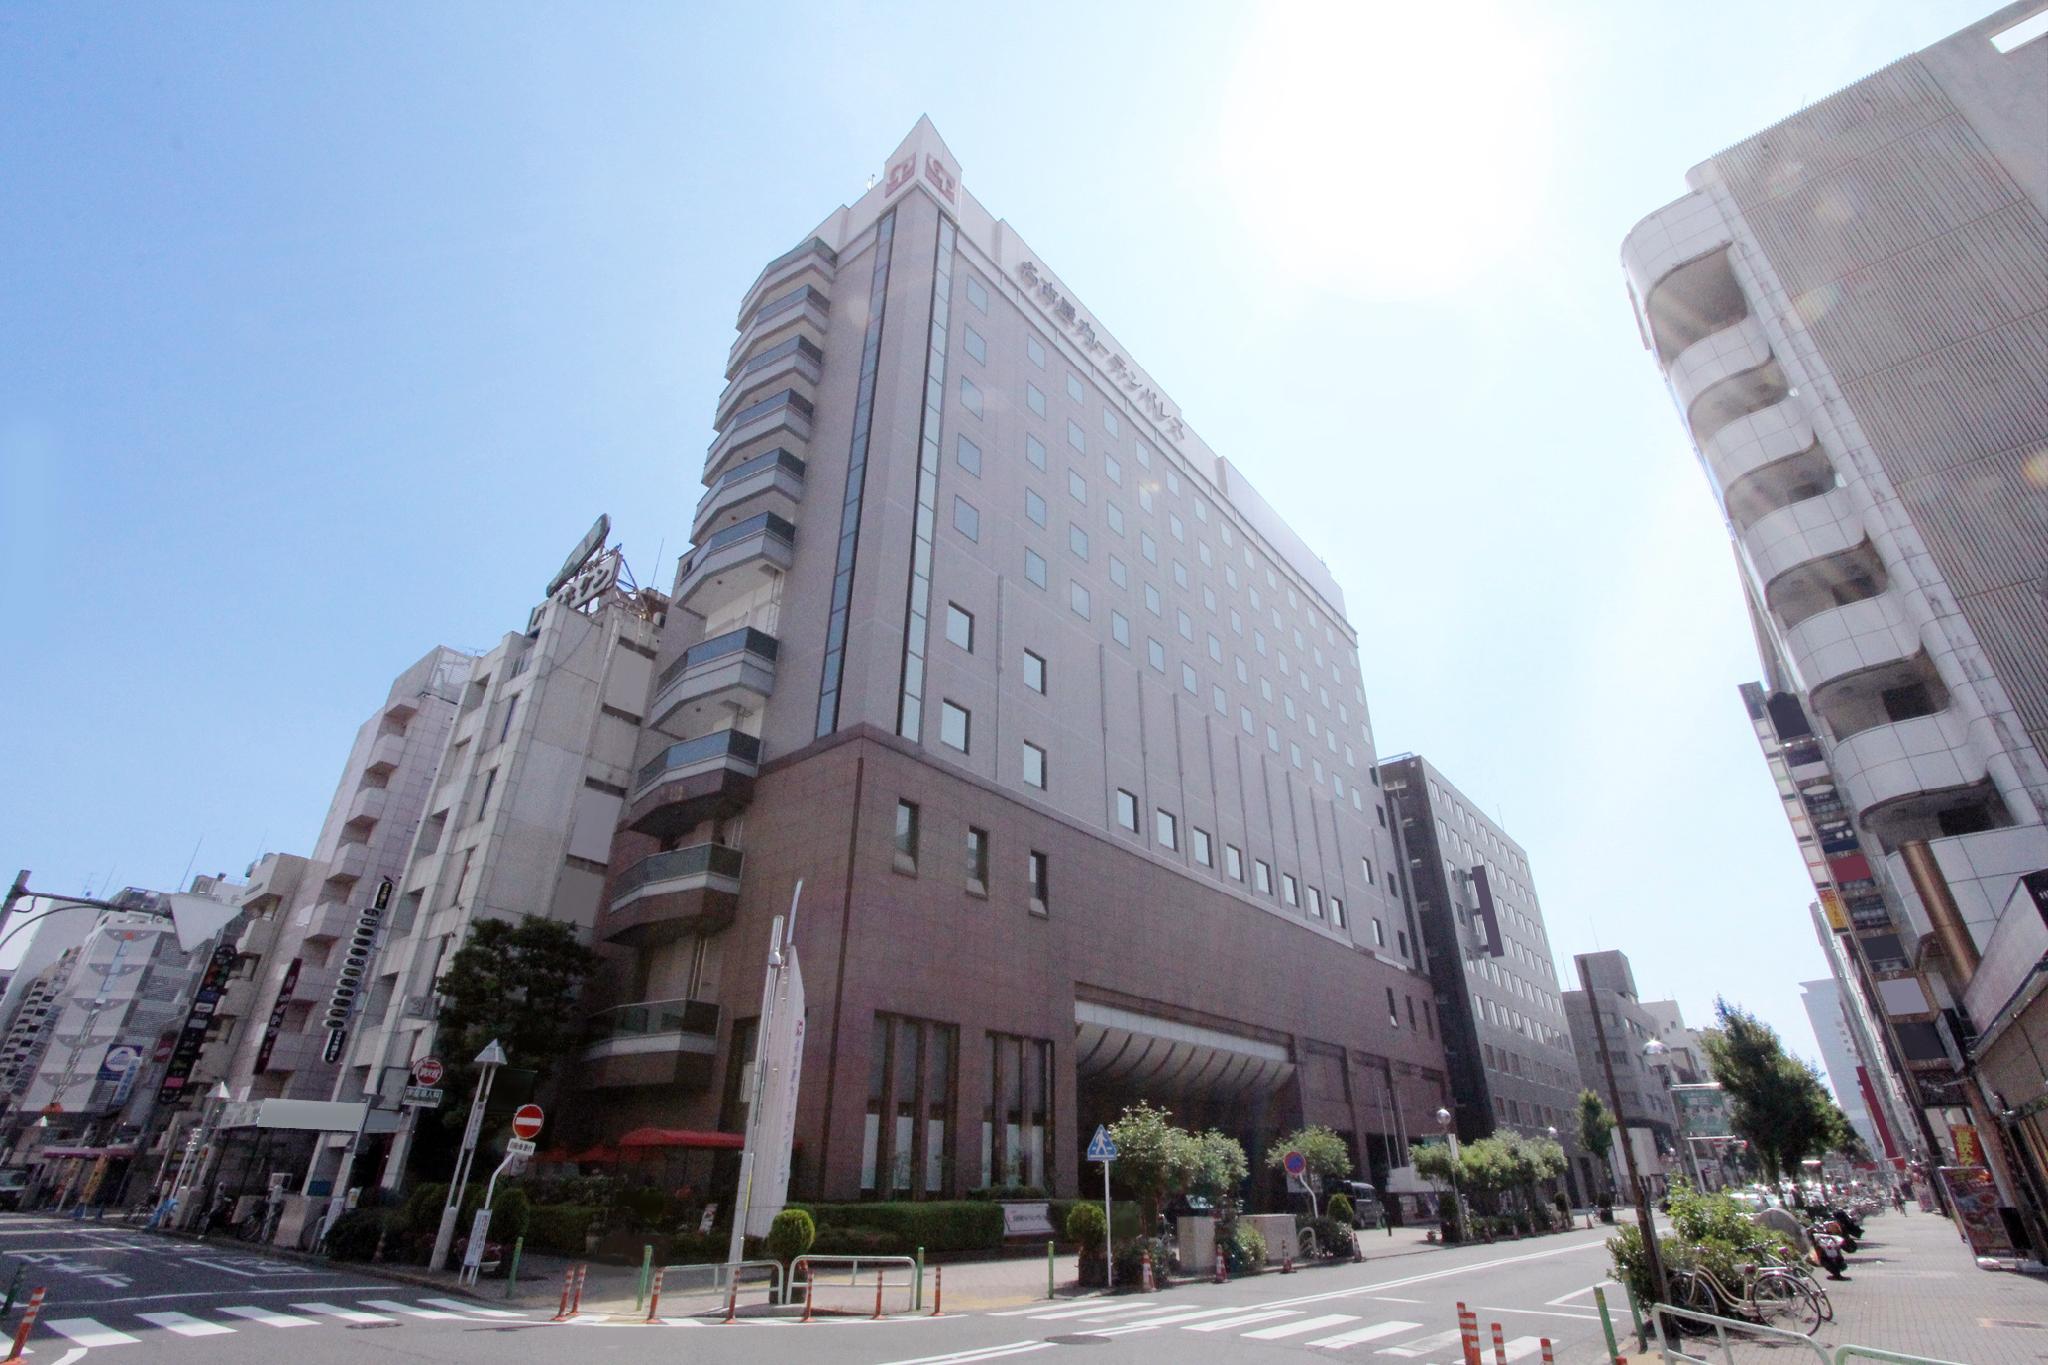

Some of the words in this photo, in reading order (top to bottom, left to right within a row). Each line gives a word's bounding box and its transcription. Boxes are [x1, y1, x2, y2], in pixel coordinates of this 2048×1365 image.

[1021, 261, 1185, 440] 名古屋ガーデンパレス
